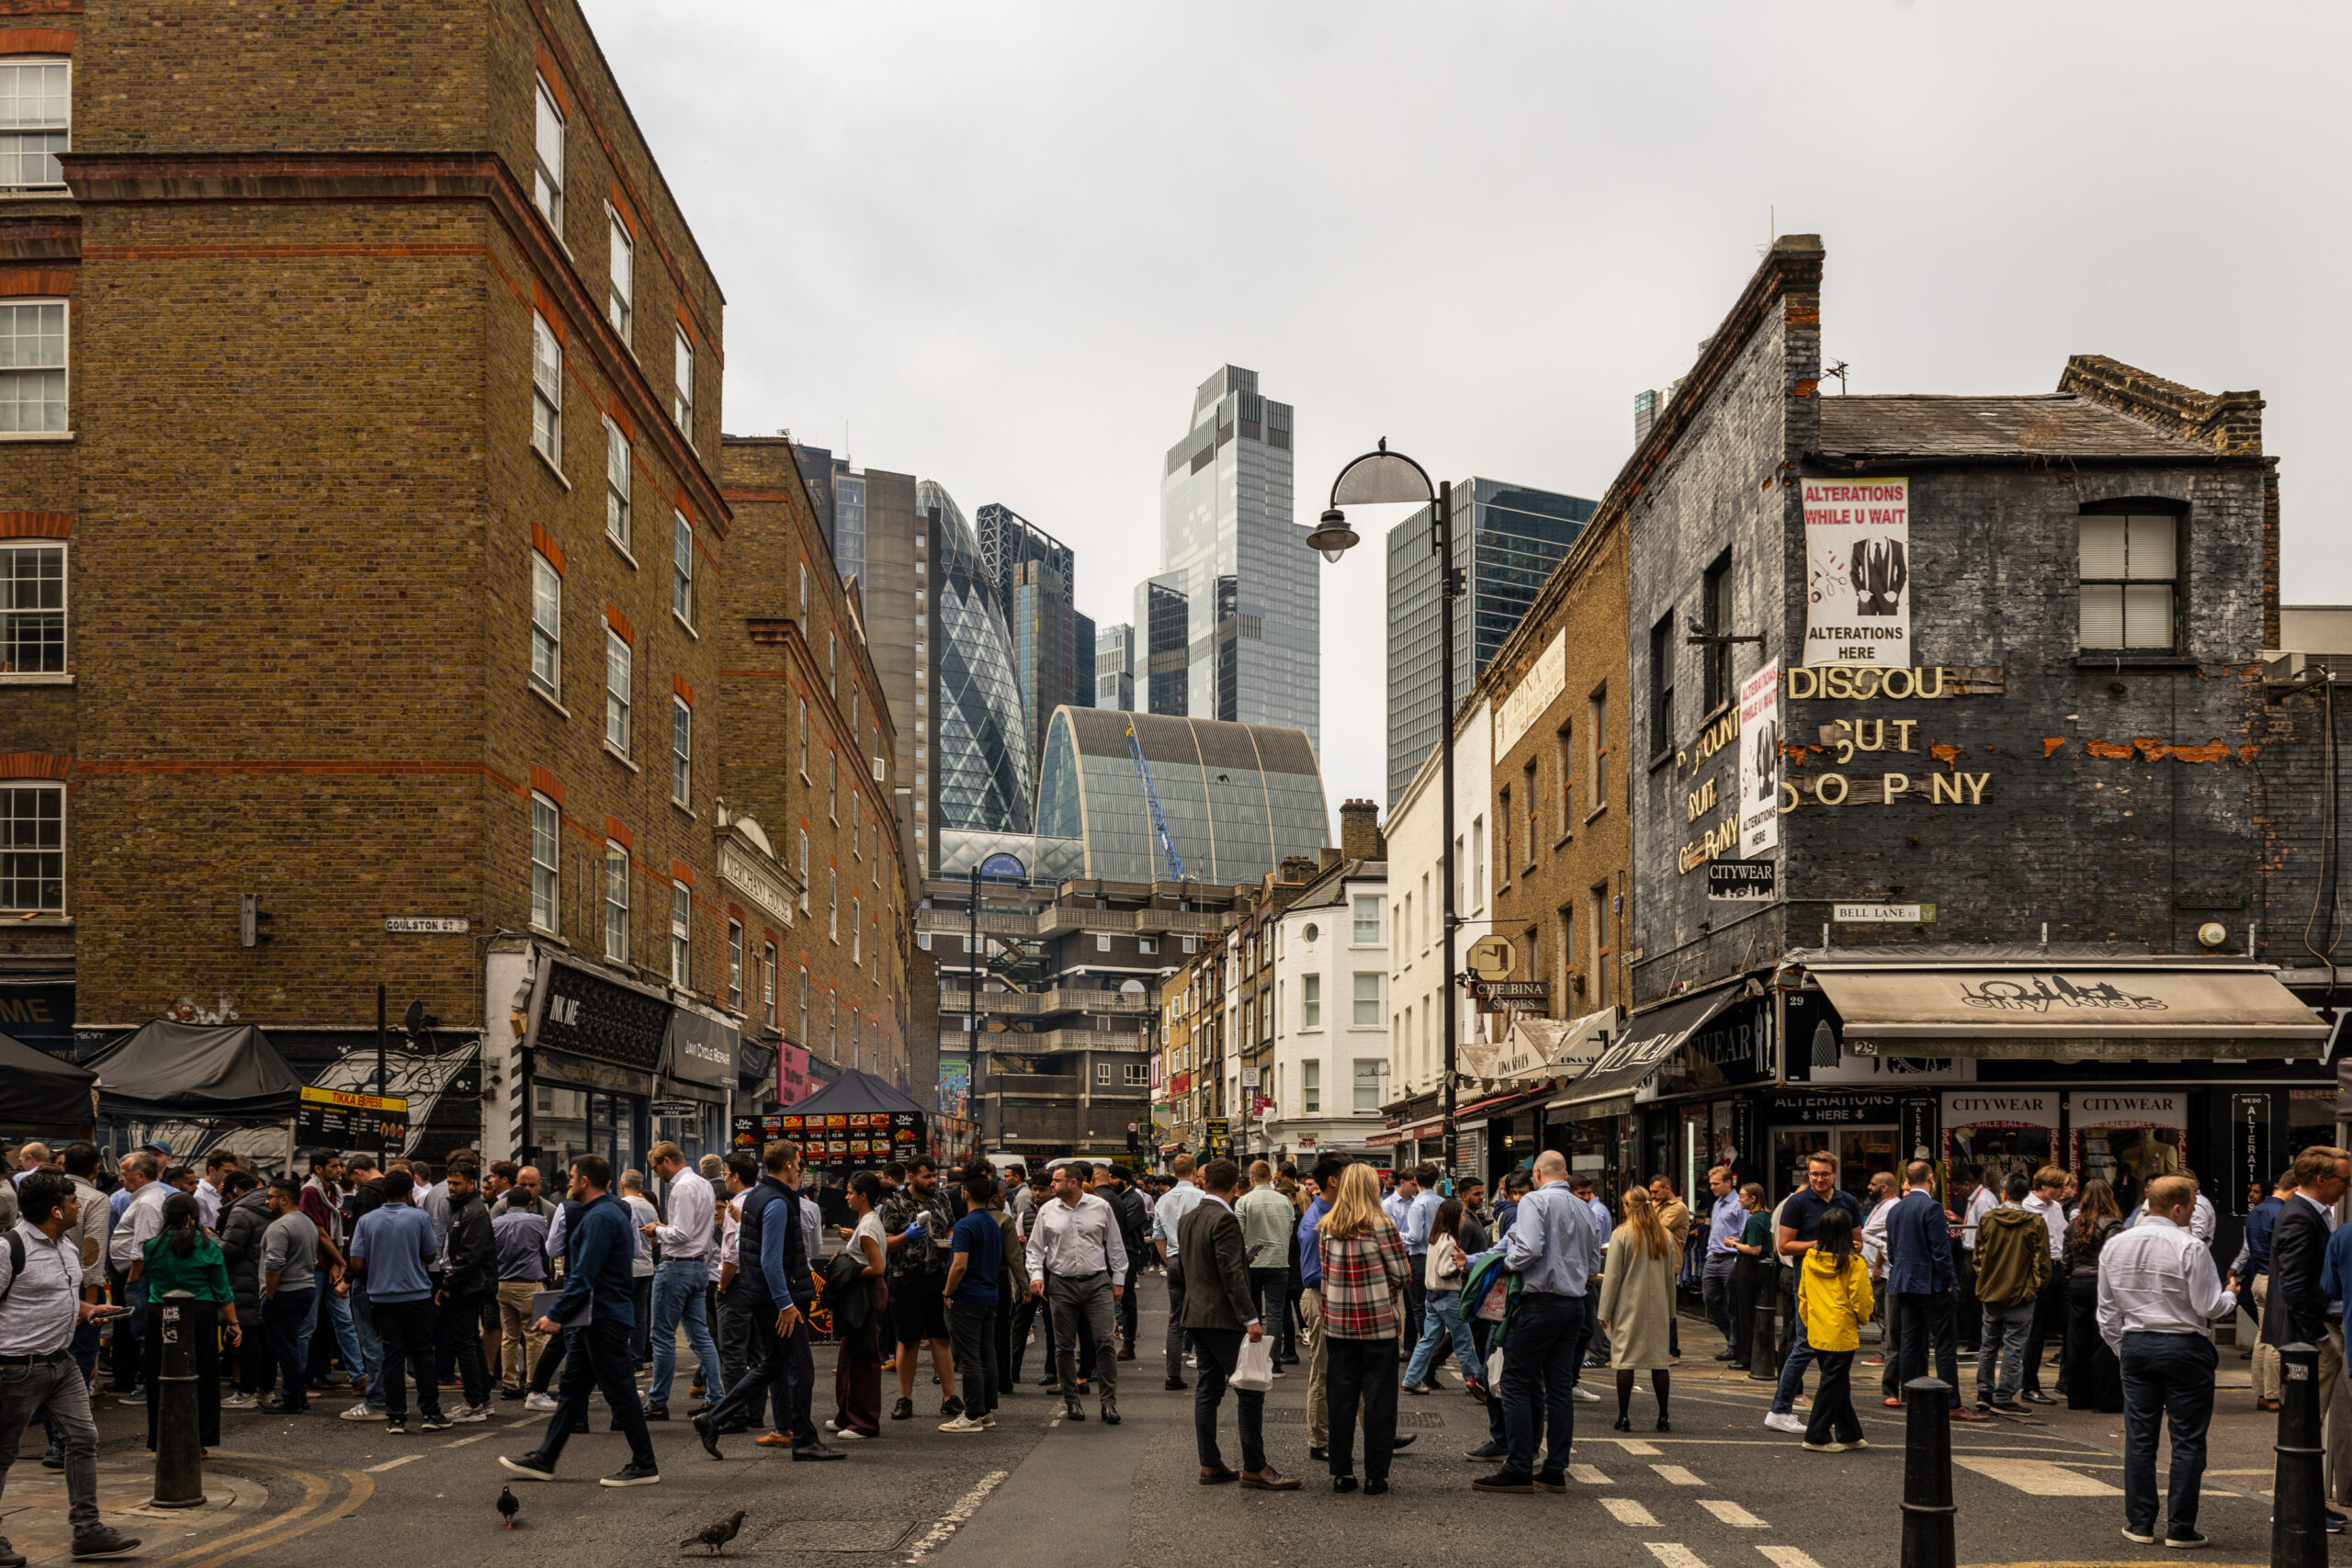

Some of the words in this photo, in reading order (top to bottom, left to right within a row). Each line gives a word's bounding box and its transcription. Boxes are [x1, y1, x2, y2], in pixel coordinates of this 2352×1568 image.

[1804, 486, 1904, 502] ALTERATIONS
[1804, 509, 1850, 525] WHILE
[1855, 509, 1865, 525] U
[1869, 509, 1905, 525] WAIT
[1809, 627, 1903, 640] ALTERATIONS
[1839, 647, 1875, 660] HERE
[1742, 671, 1777, 704] ALTERATIONS
[1742, 704, 1758, 725] WHILE
[1758, 699, 1764, 713] U
[1764, 687, 1778, 710] WAIT
[1743, 805, 1776, 832] ALTERATIONS
[1752, 829, 1766, 846] HERE
[1710, 864, 1772, 880] CITYWEAR
[767, 886, 788, 919] HOUSE
[1839, 908, 1870, 917] BELL
[1875, 908, 1905, 917] LANE
[387, 921, 438, 930] GOULSTON
[1510, 984, 1544, 995] BINA
[1789, 997, 1804, 1006] 29
[2059, 992, 2169, 1010] kids
[549, 994, 564, 1023] INK
[564, 998, 580, 1026] ME
[684, 1040, 697, 1055] JAVI
[697, 1043, 714, 1061] CYCLE
[714, 1047, 730, 1066] REPAIR
[1857, 1042, 1876, 1054] 29
[1498, 1058, 1511, 1077] BINA
[333, 1092, 356, 1105] TIKKA
[1775, 1096, 1894, 1107] ALTERATIONS
[1952, 1098, 2043, 1111] CITYWEAR
[2083, 1098, 2174, 1111] CITYWEAR
[1816, 1110, 1849, 1121] HERE
[1003, 1145, 1037, 1155] TANLEY
[1962, 1155, 2037, 1165] ALTERATIONS
[1988, 1165, 2016, 1174] HERE
